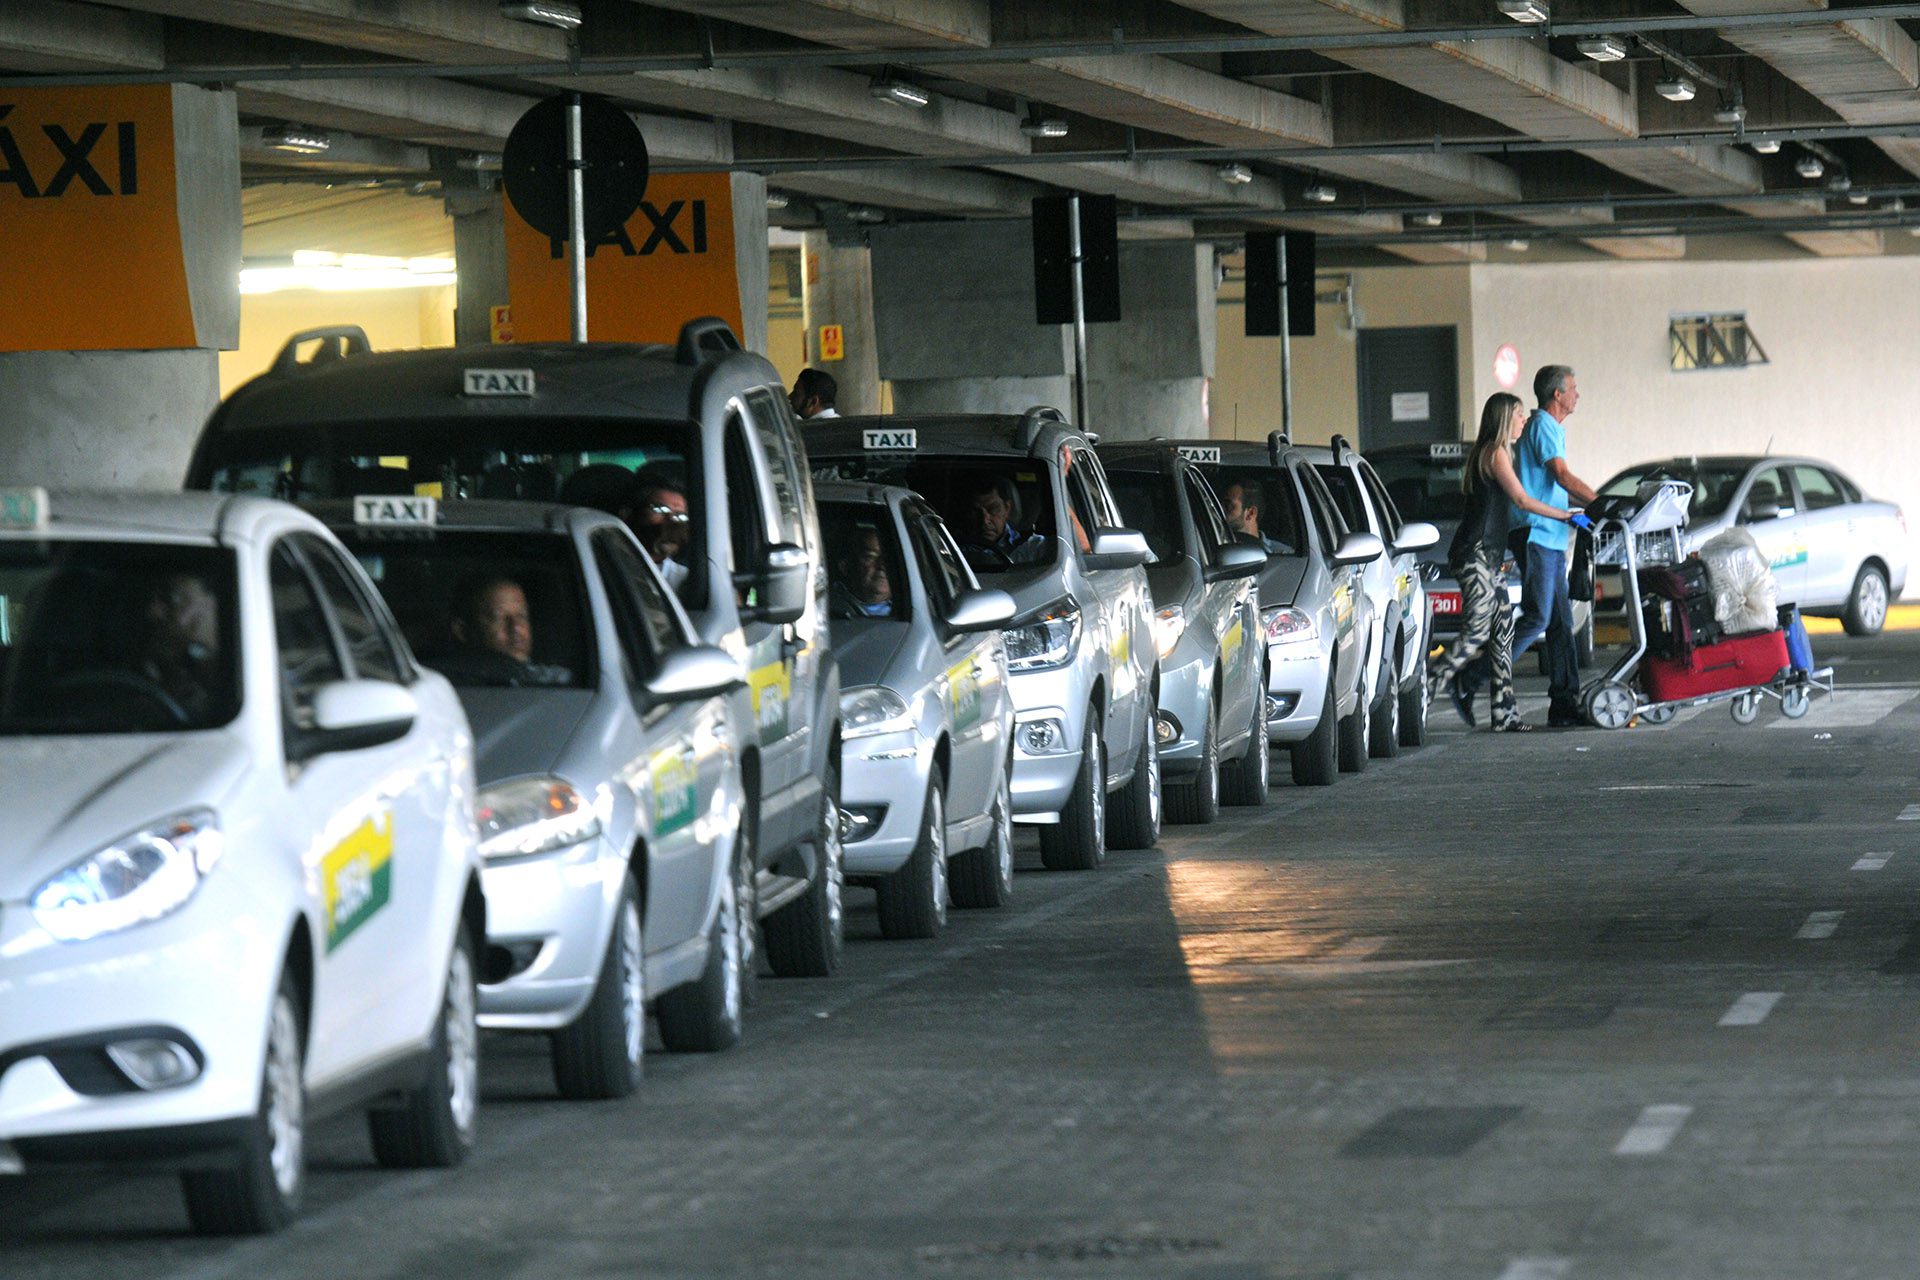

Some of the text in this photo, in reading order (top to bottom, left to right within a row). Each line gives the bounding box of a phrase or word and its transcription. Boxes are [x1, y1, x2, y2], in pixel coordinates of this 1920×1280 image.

[469, 373, 528, 391] TAXI
[866, 433, 912, 446] TAXI
[1180, 450, 1217, 460] TAXI
[1433, 445, 1460, 454] TAXI
[361, 501, 429, 519] TAXI
